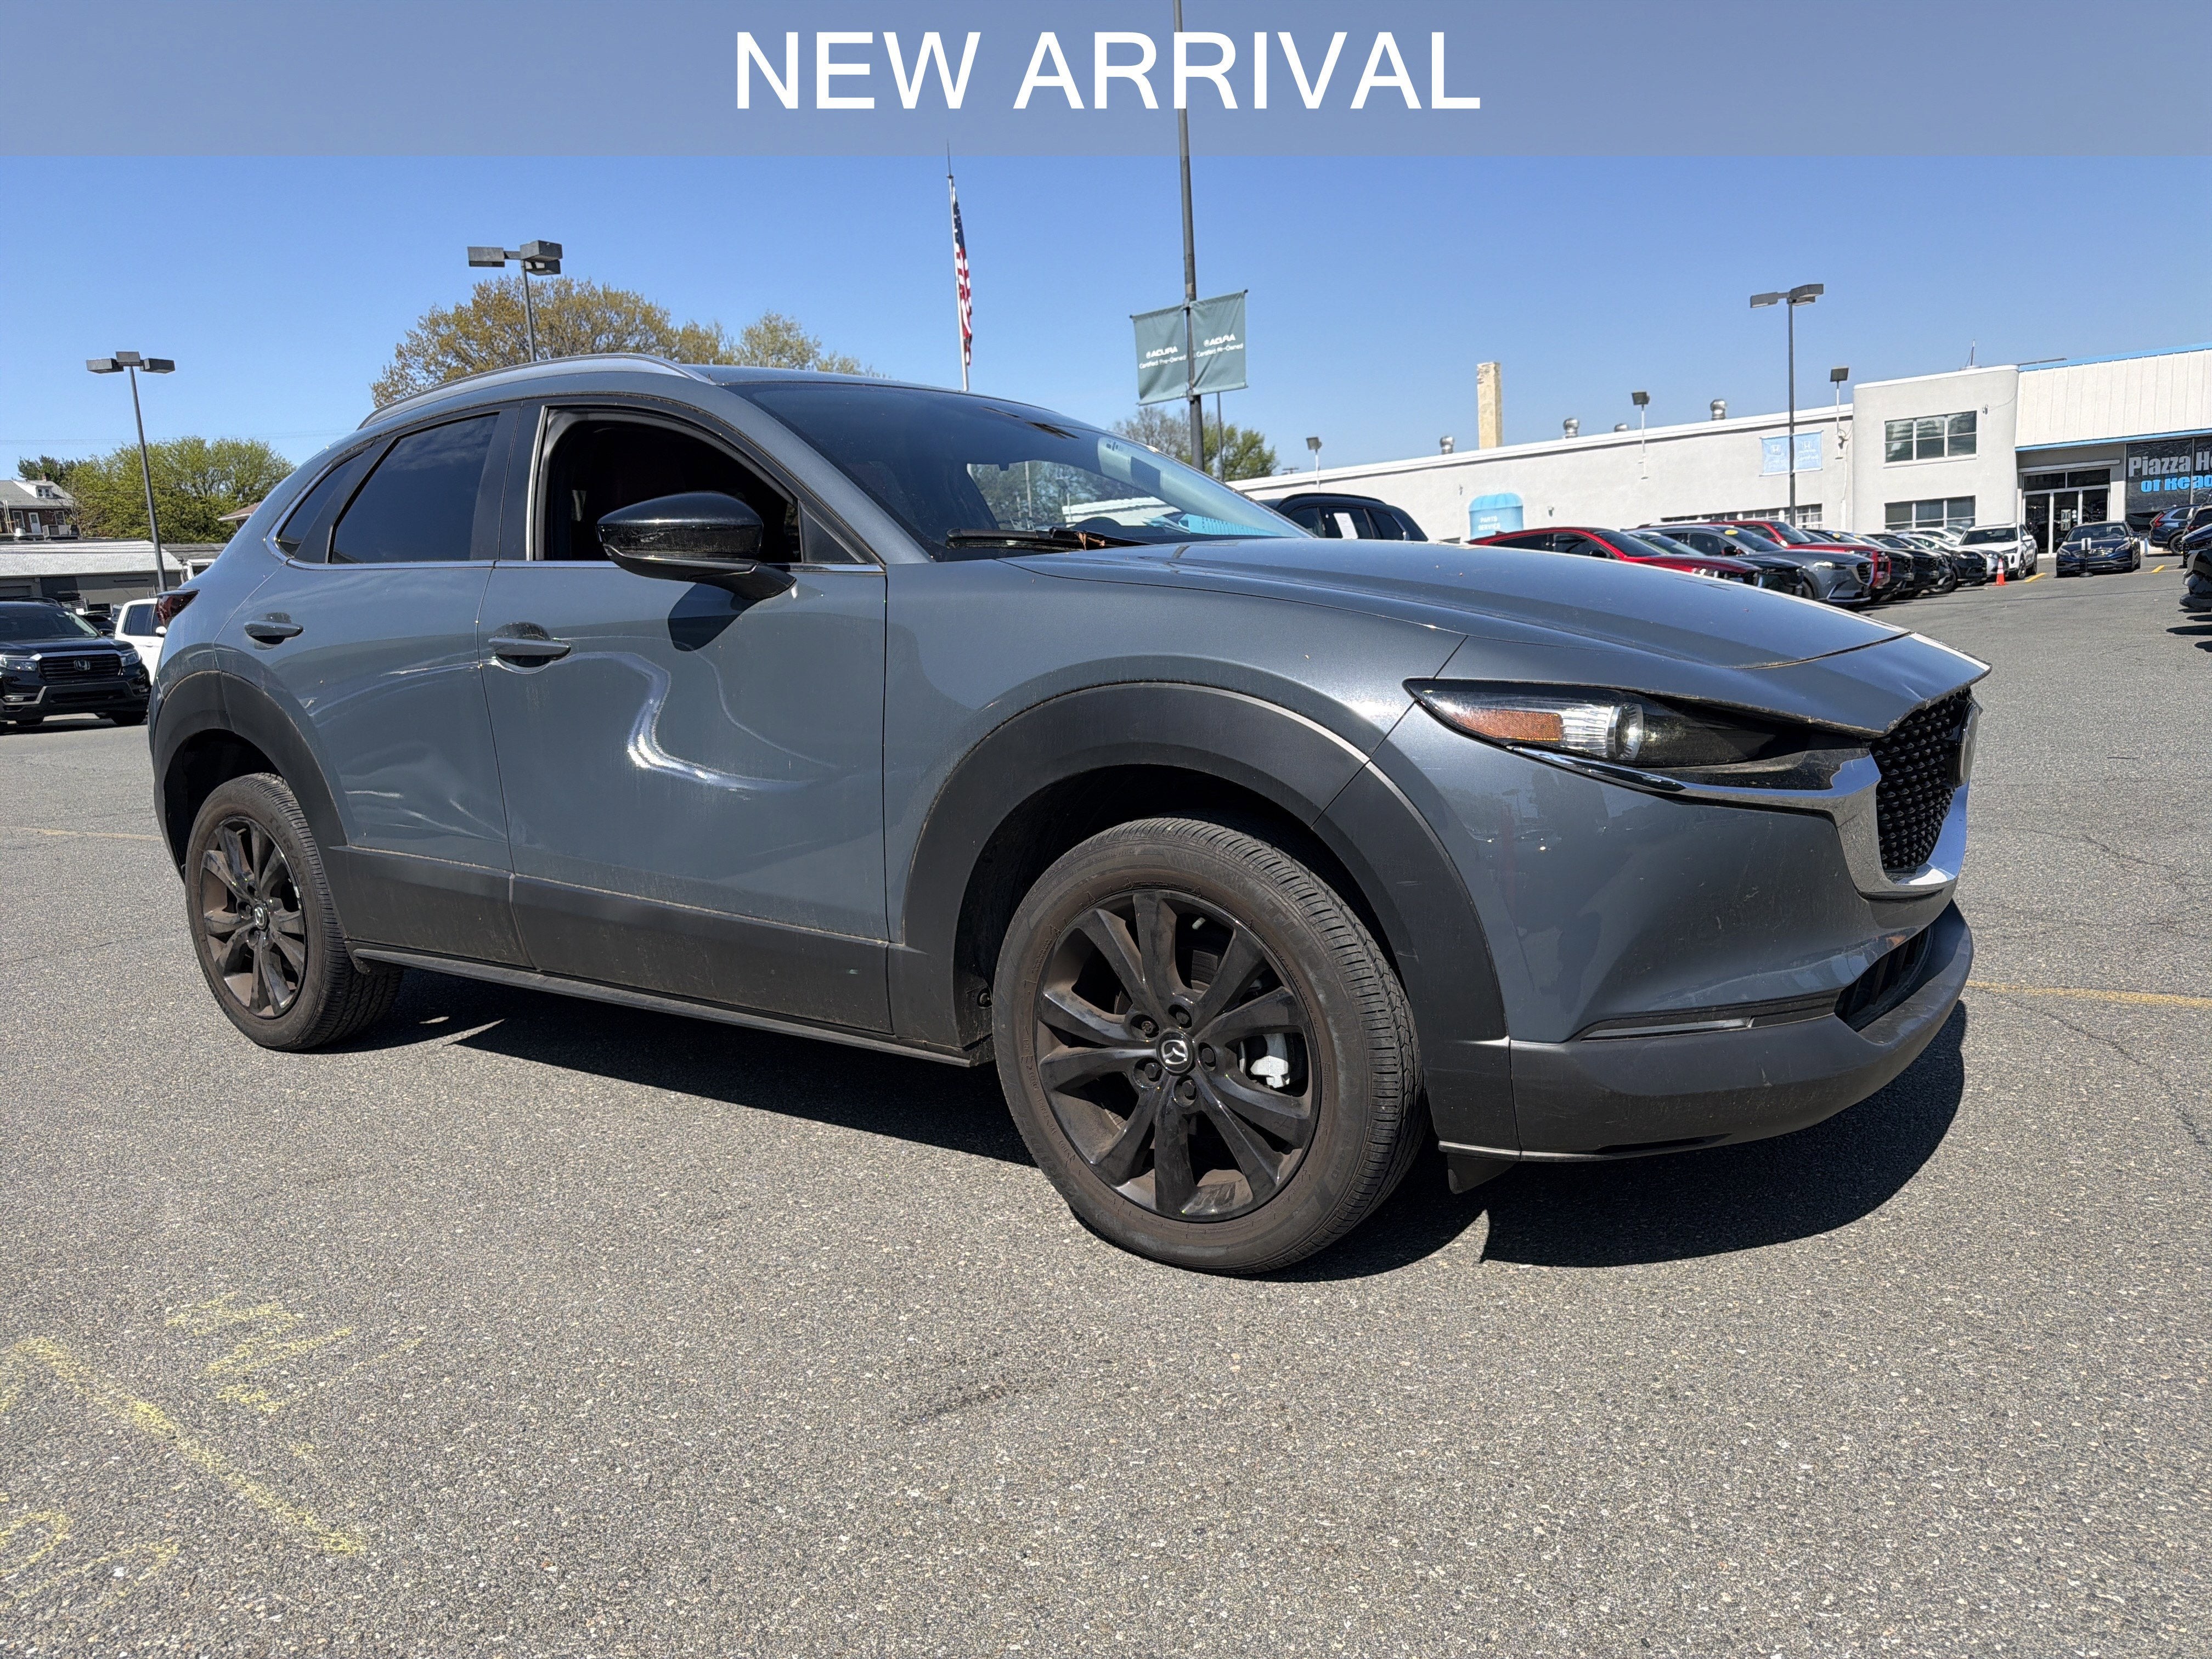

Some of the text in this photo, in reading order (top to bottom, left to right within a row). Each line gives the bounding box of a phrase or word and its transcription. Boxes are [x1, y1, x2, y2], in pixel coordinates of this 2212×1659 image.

[1209, 334, 1235, 346] ACURA
[1151, 346, 1178, 357] ACURA
[1139, 360, 1158, 369] Certified
[2129, 451, 2212, 477] Piazza H
[1478, 523, 1500, 531] SERVICE
